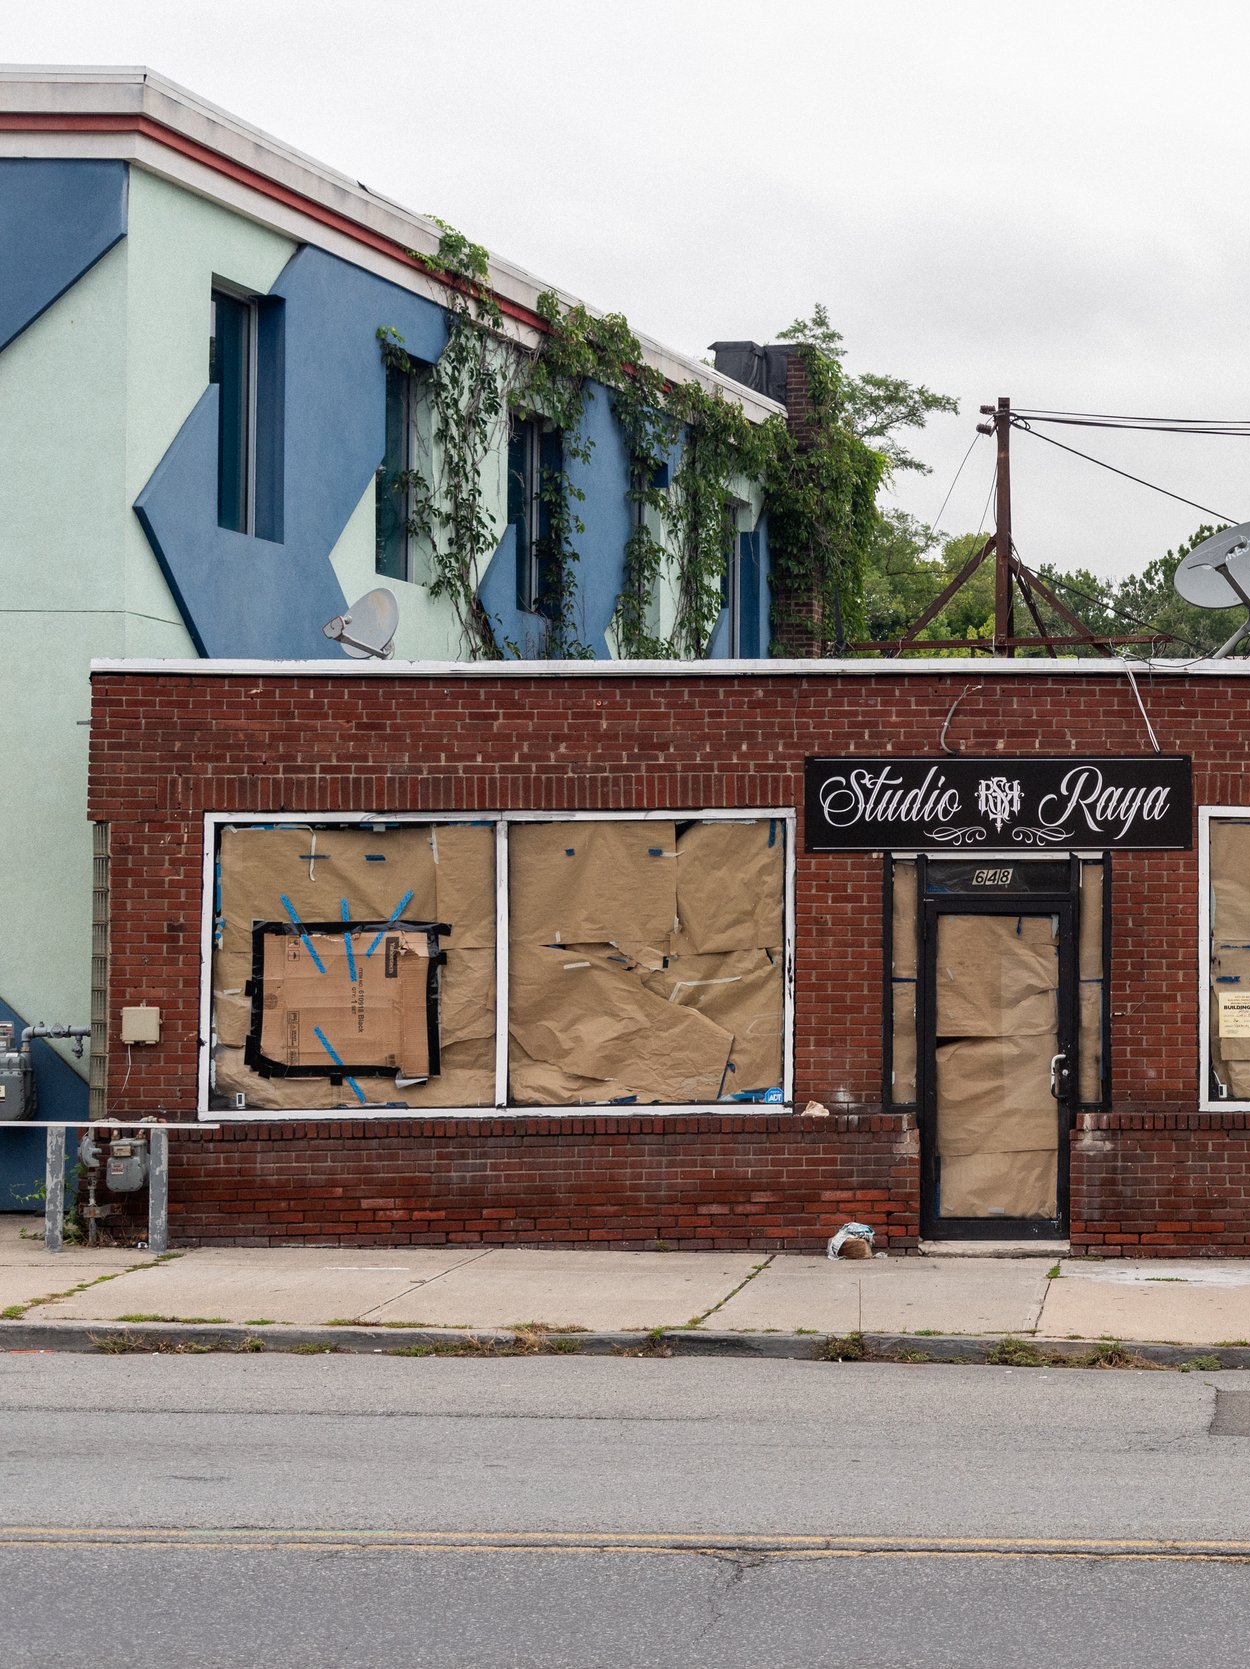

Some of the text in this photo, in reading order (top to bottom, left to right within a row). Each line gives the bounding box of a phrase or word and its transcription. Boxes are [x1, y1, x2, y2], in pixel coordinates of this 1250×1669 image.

[818, 765, 963, 828] Studio
[1038, 765, 1172, 840] Raya
[975, 870, 1011, 884] 648
[768, 1093, 782, 1102] ADT
